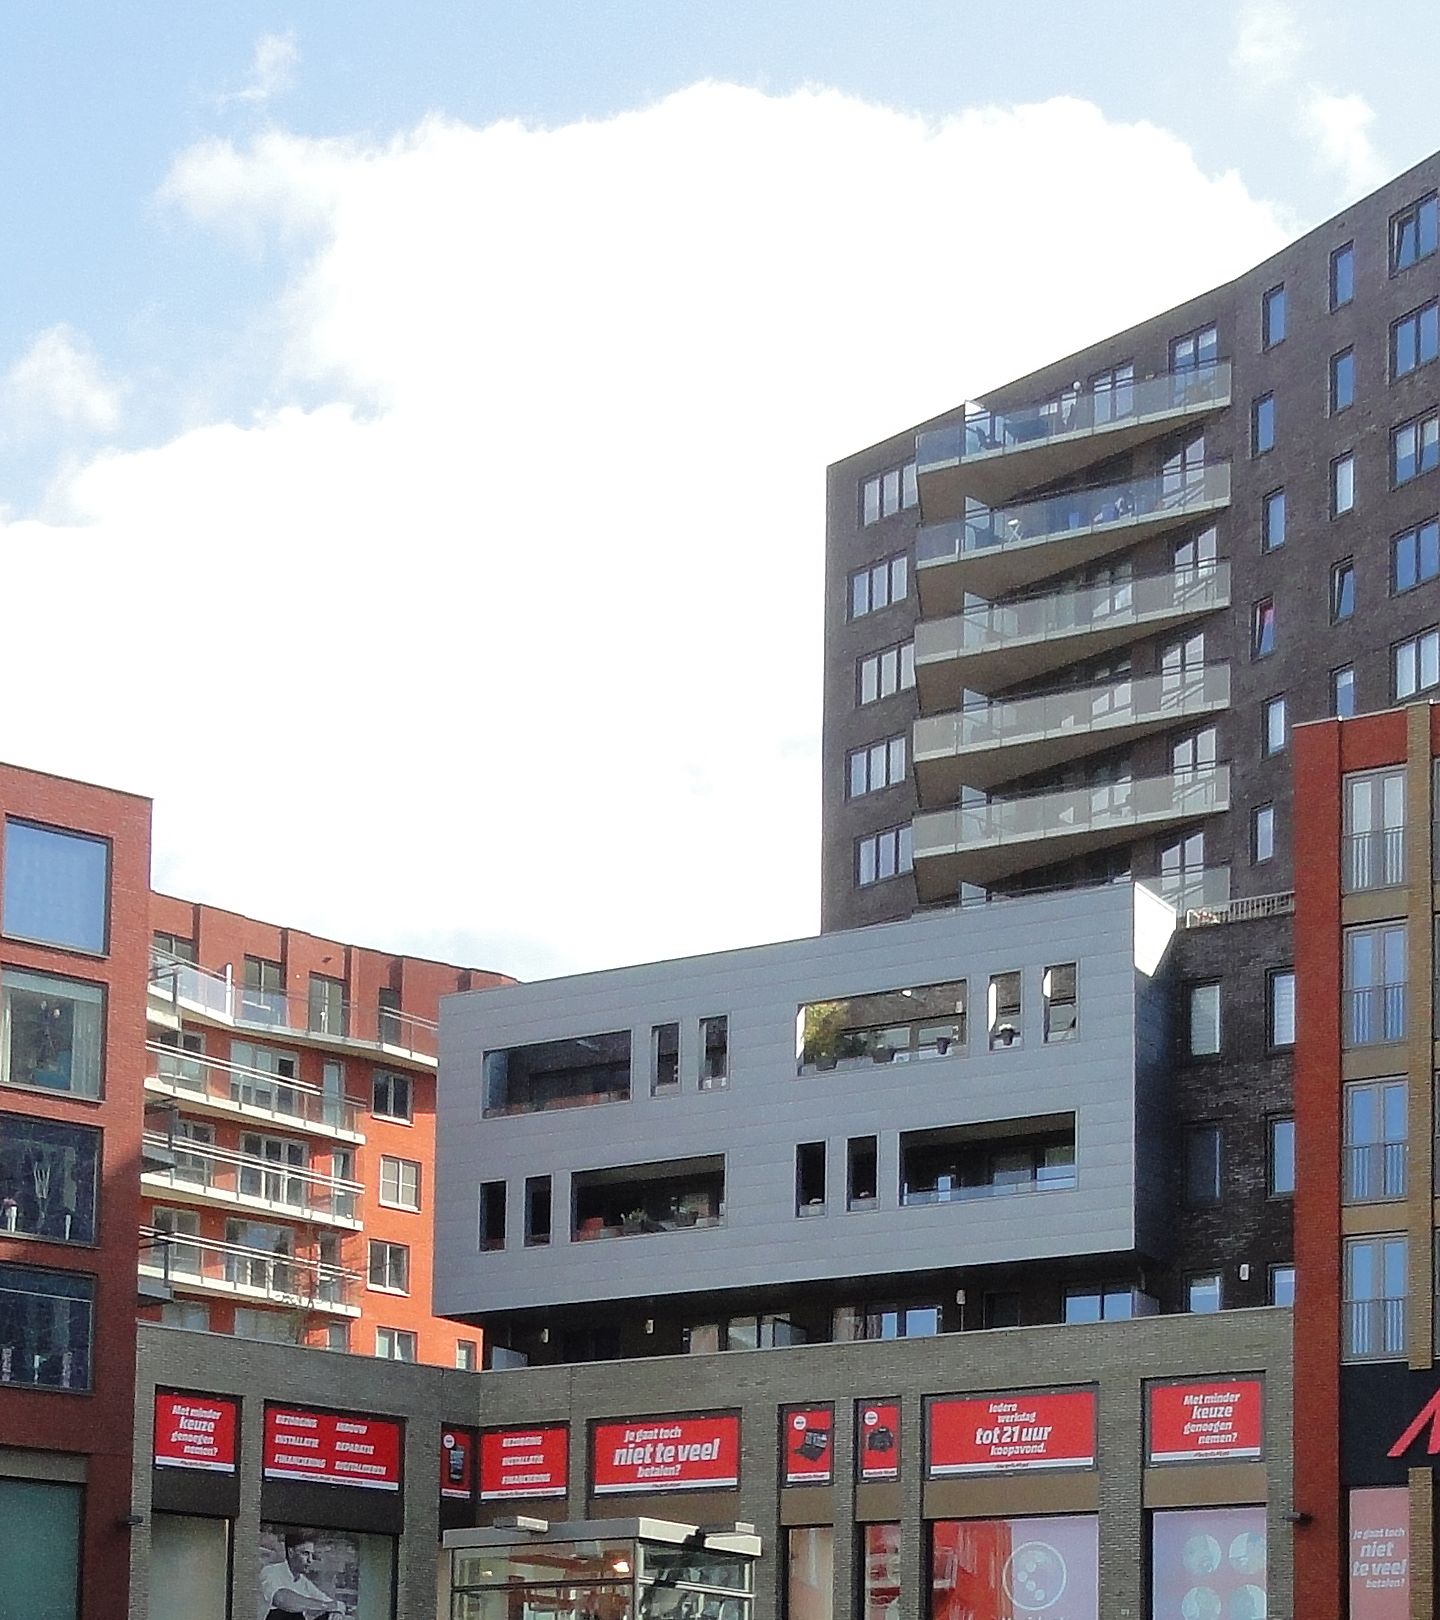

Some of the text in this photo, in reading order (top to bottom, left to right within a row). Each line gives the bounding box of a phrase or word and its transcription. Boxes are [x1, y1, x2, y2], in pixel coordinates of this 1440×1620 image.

[1204, 1392, 1241, 1404] minder
[1192, 1405, 1233, 1419] keuze
[179, 1416, 215, 1432] keuze
[1183, 1421, 1232, 1435] genoegen
[975, 1424, 1052, 1445] tot 21 uur
[613, 1438, 720, 1467] niet te veel
[1360, 1541, 1394, 1558] niet
[1352, 1558, 1408, 1576] te veel
